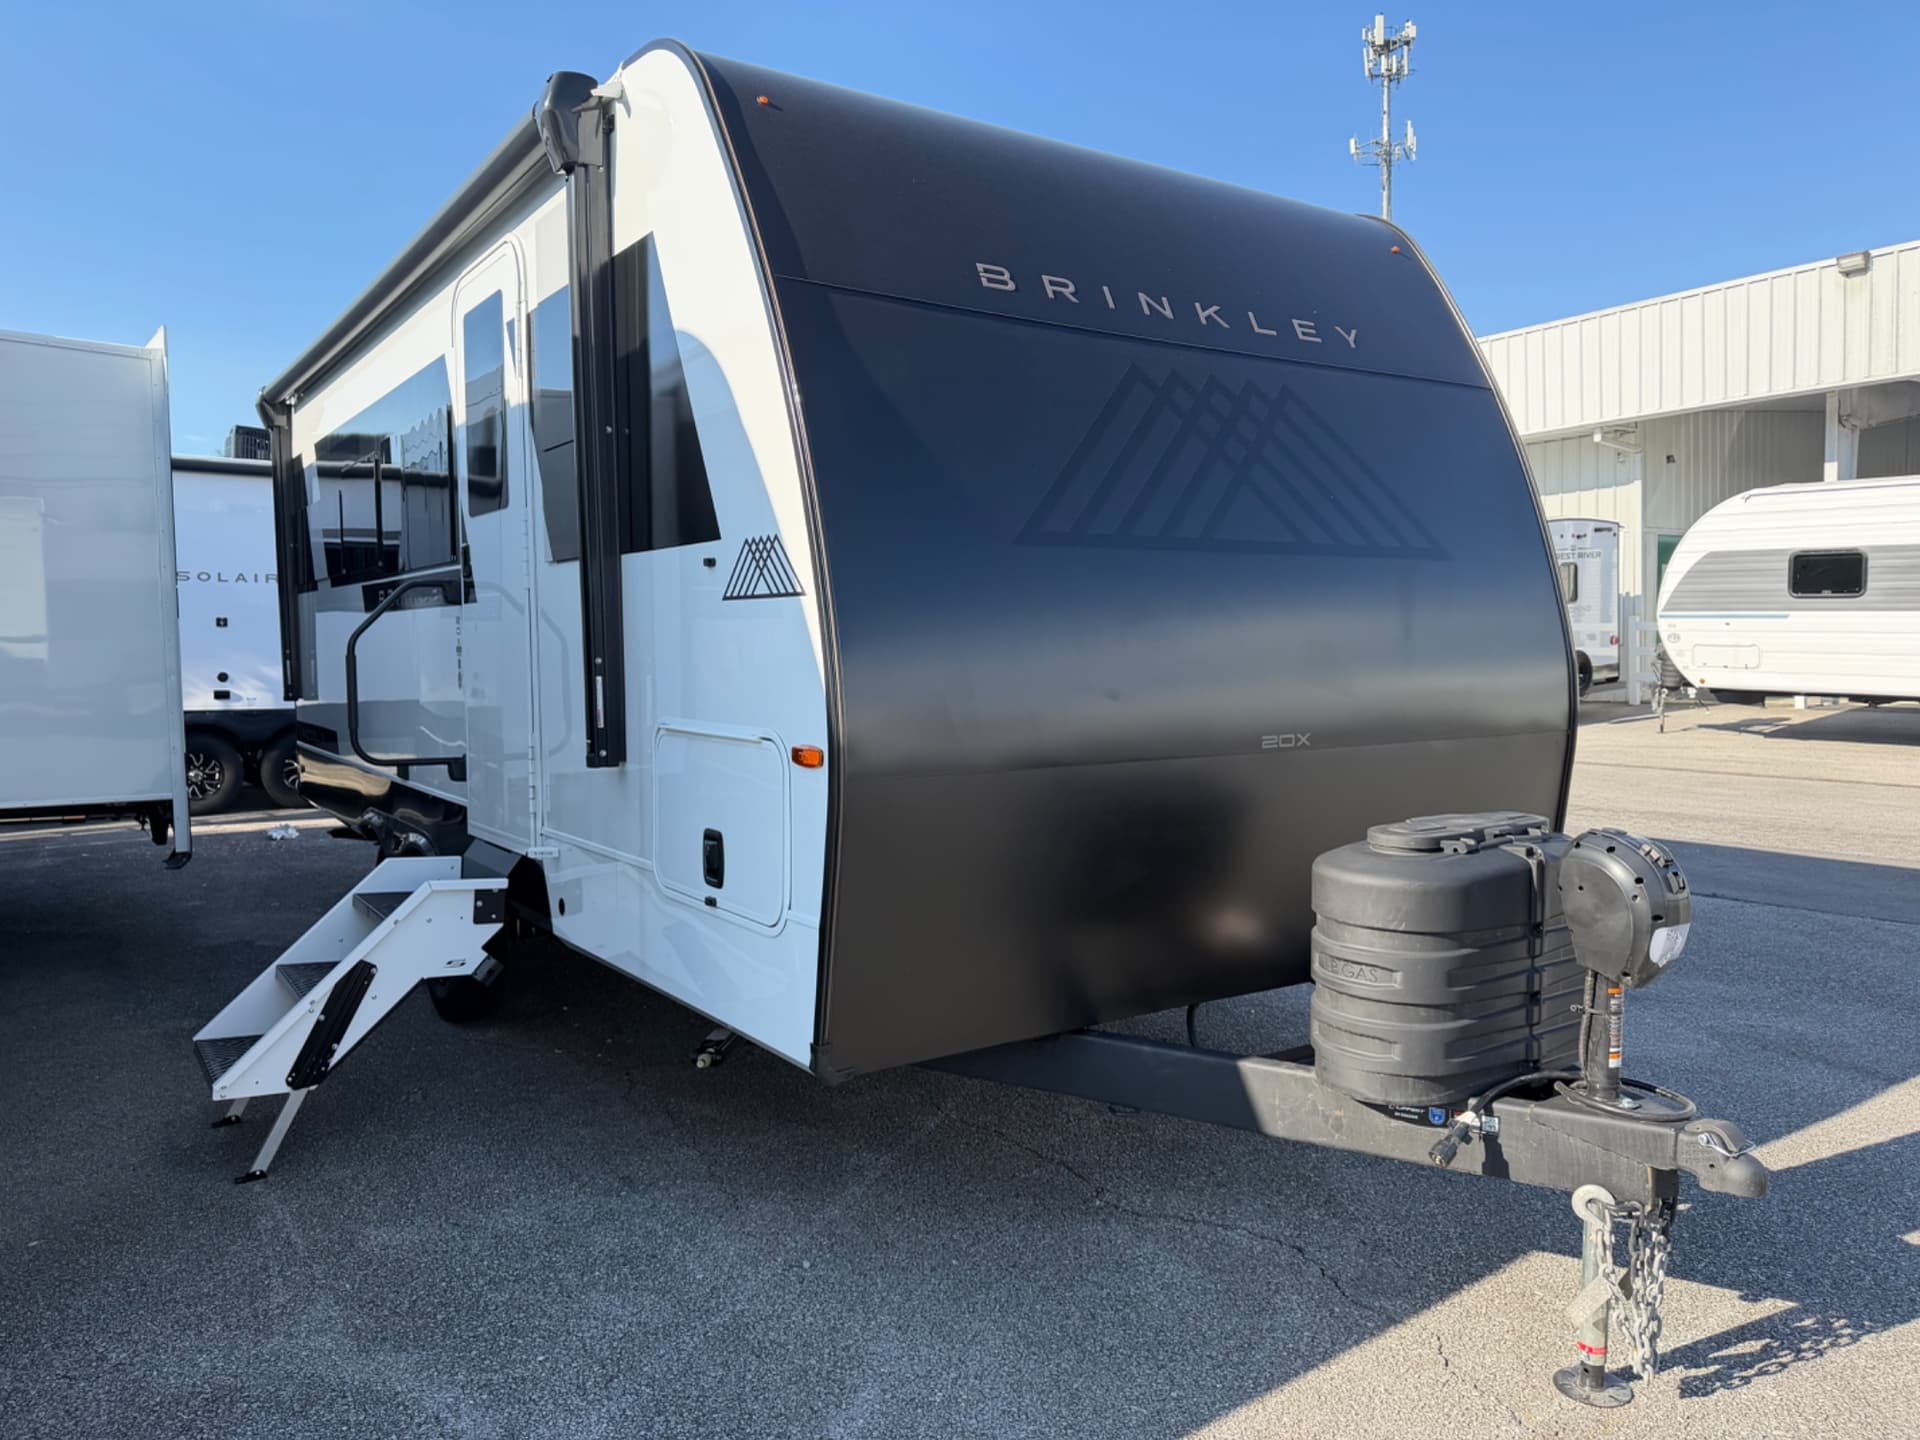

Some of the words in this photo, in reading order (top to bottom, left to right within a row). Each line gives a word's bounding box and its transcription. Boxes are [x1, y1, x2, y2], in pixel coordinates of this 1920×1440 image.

[976, 262, 1358, 348] BRINKLEY
[1261, 733, 1311, 749] 20X
[1341, 962, 1379, 983] GAS
